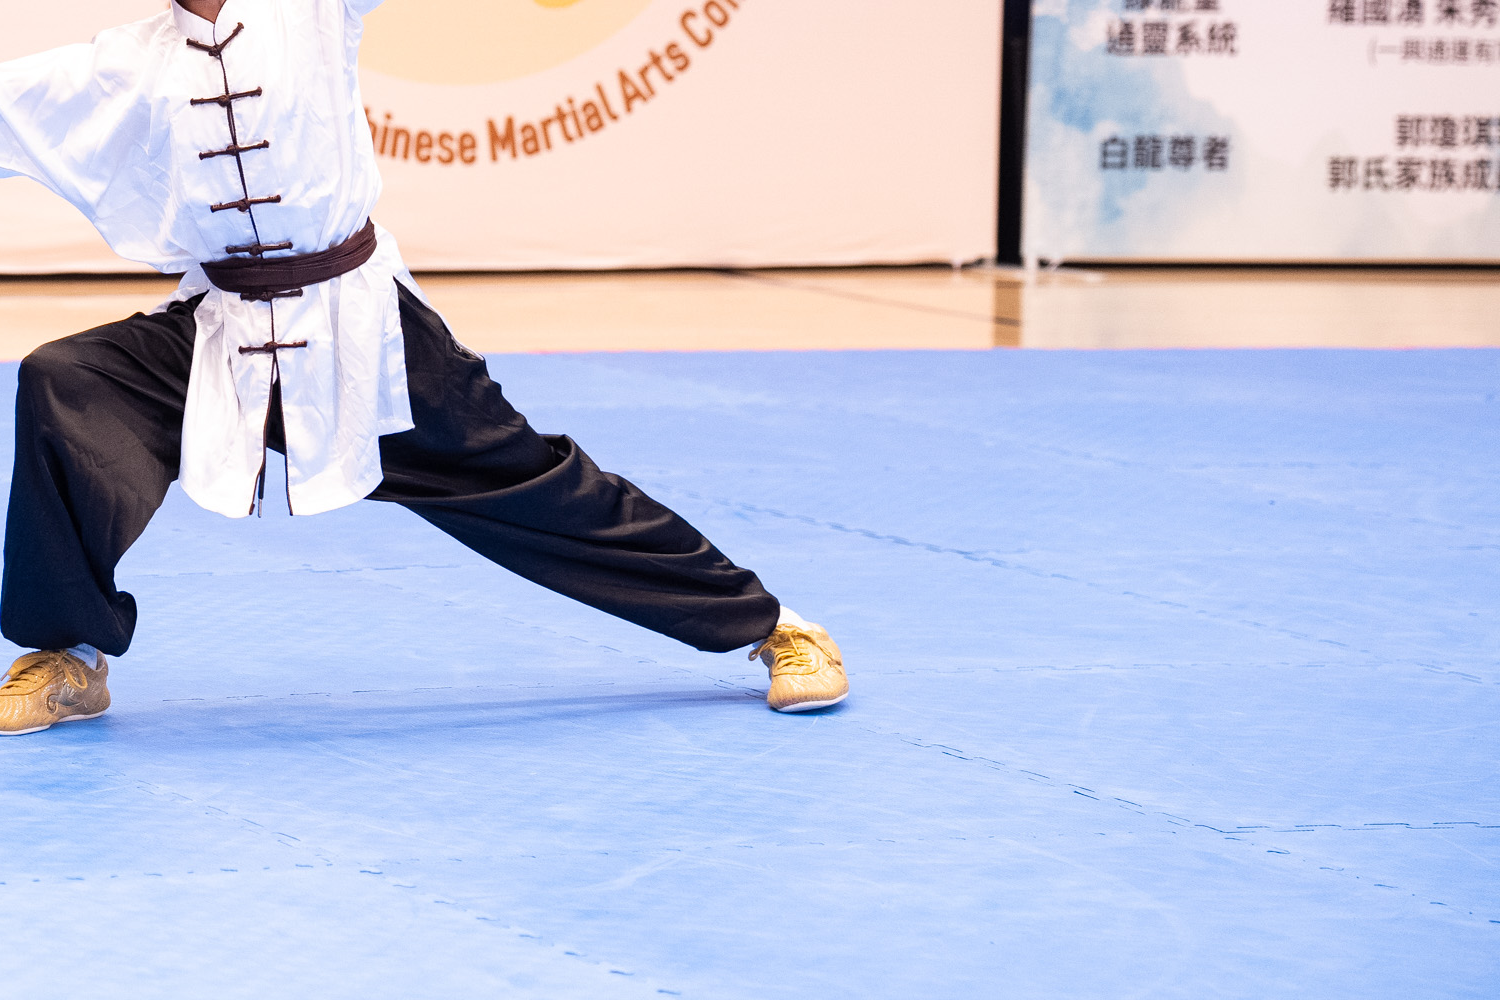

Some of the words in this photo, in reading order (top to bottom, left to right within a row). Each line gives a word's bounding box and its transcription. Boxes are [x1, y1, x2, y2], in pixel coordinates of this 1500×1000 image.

[486, 82, 619, 163] Martial
[617, 41, 691, 113] Arts
[1327, 155, 1500, 193] 郭氏家族成
